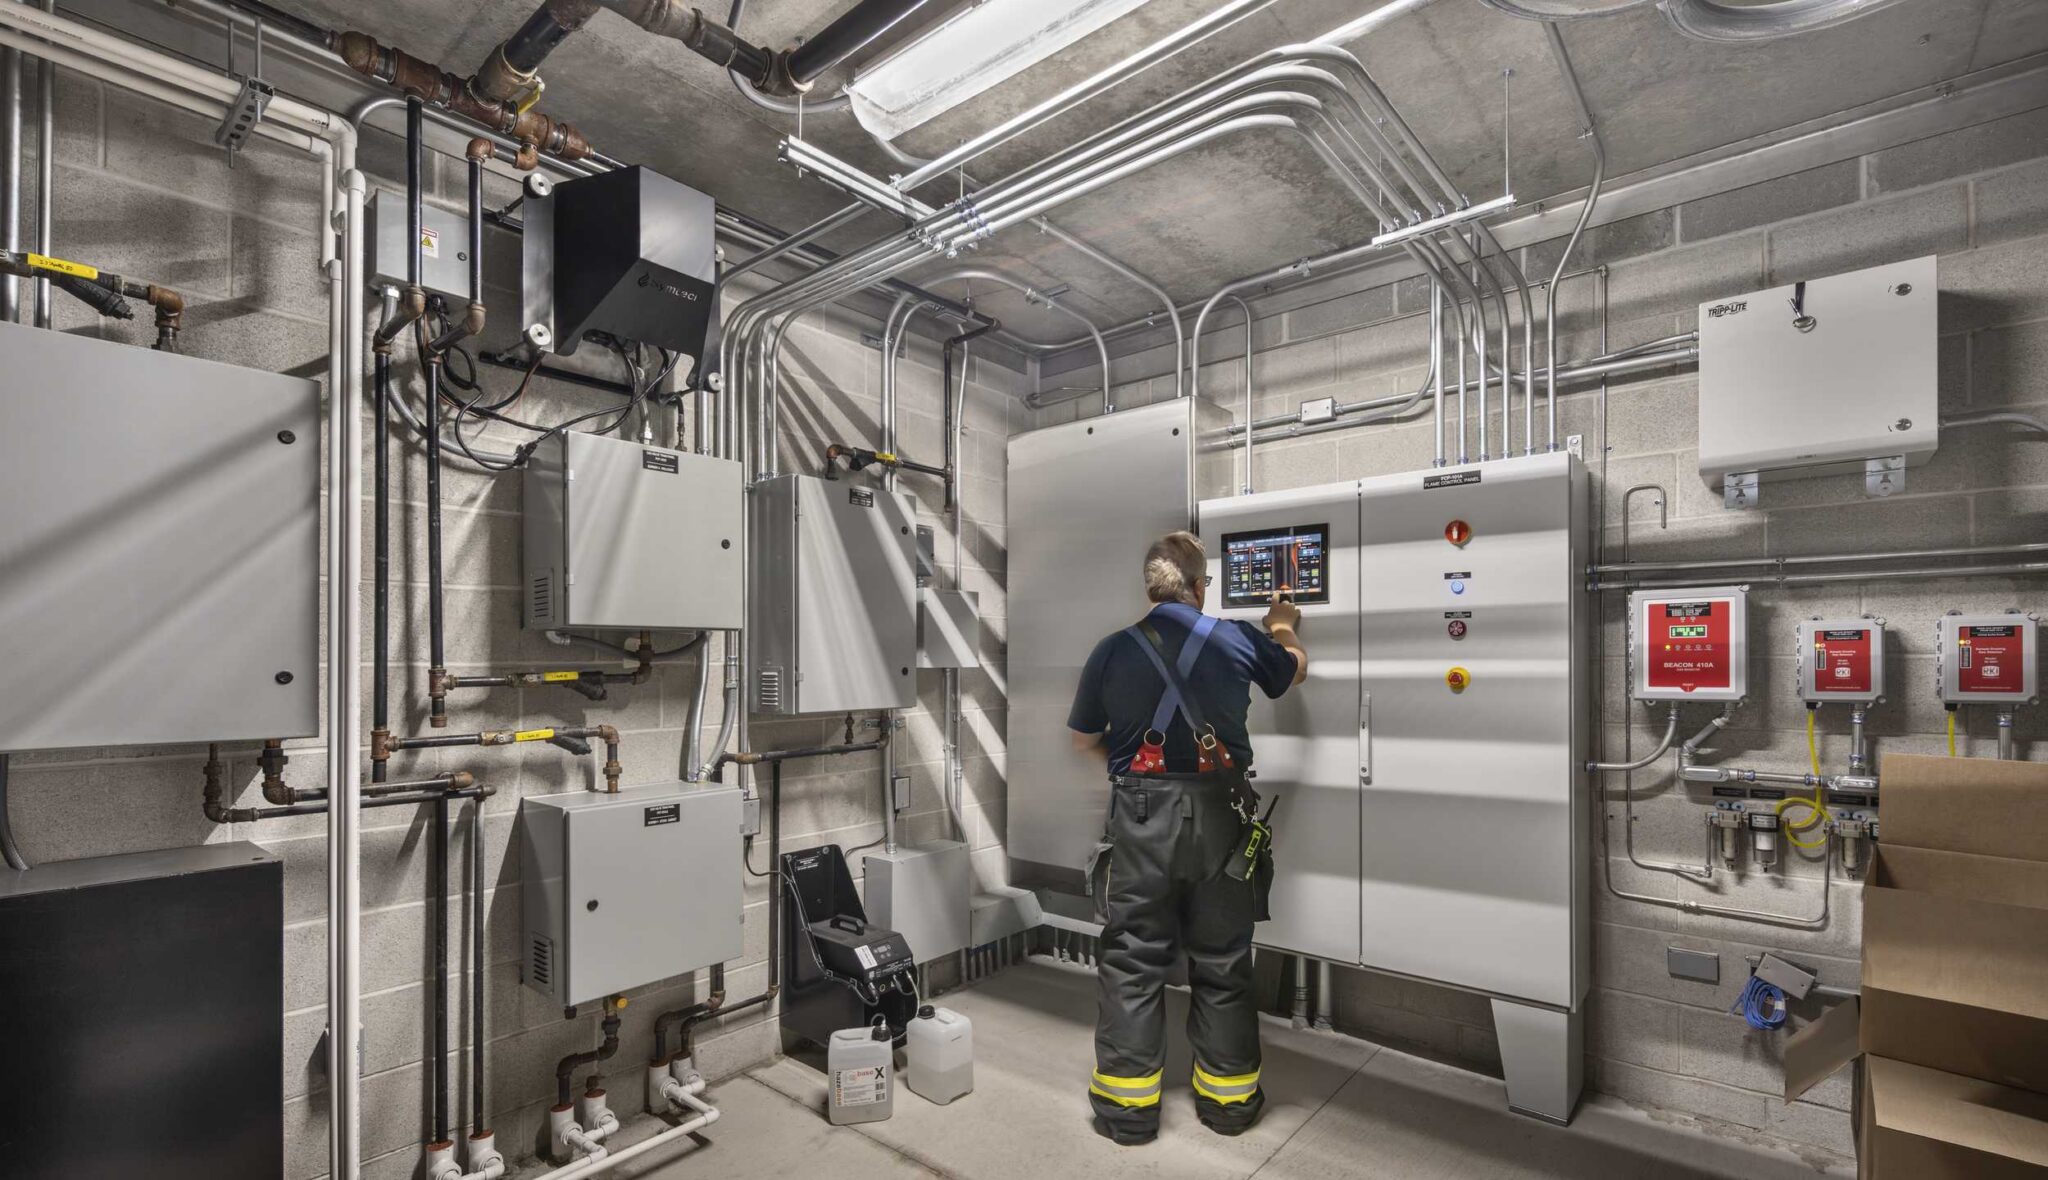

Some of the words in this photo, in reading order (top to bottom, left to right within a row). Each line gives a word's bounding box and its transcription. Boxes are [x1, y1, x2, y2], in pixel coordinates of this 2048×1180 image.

[1708, 302, 1748, 317] TRIPP-LITE
[1463, 476, 1481, 484] PANEL
[874, 1066, 885, 1080] X
